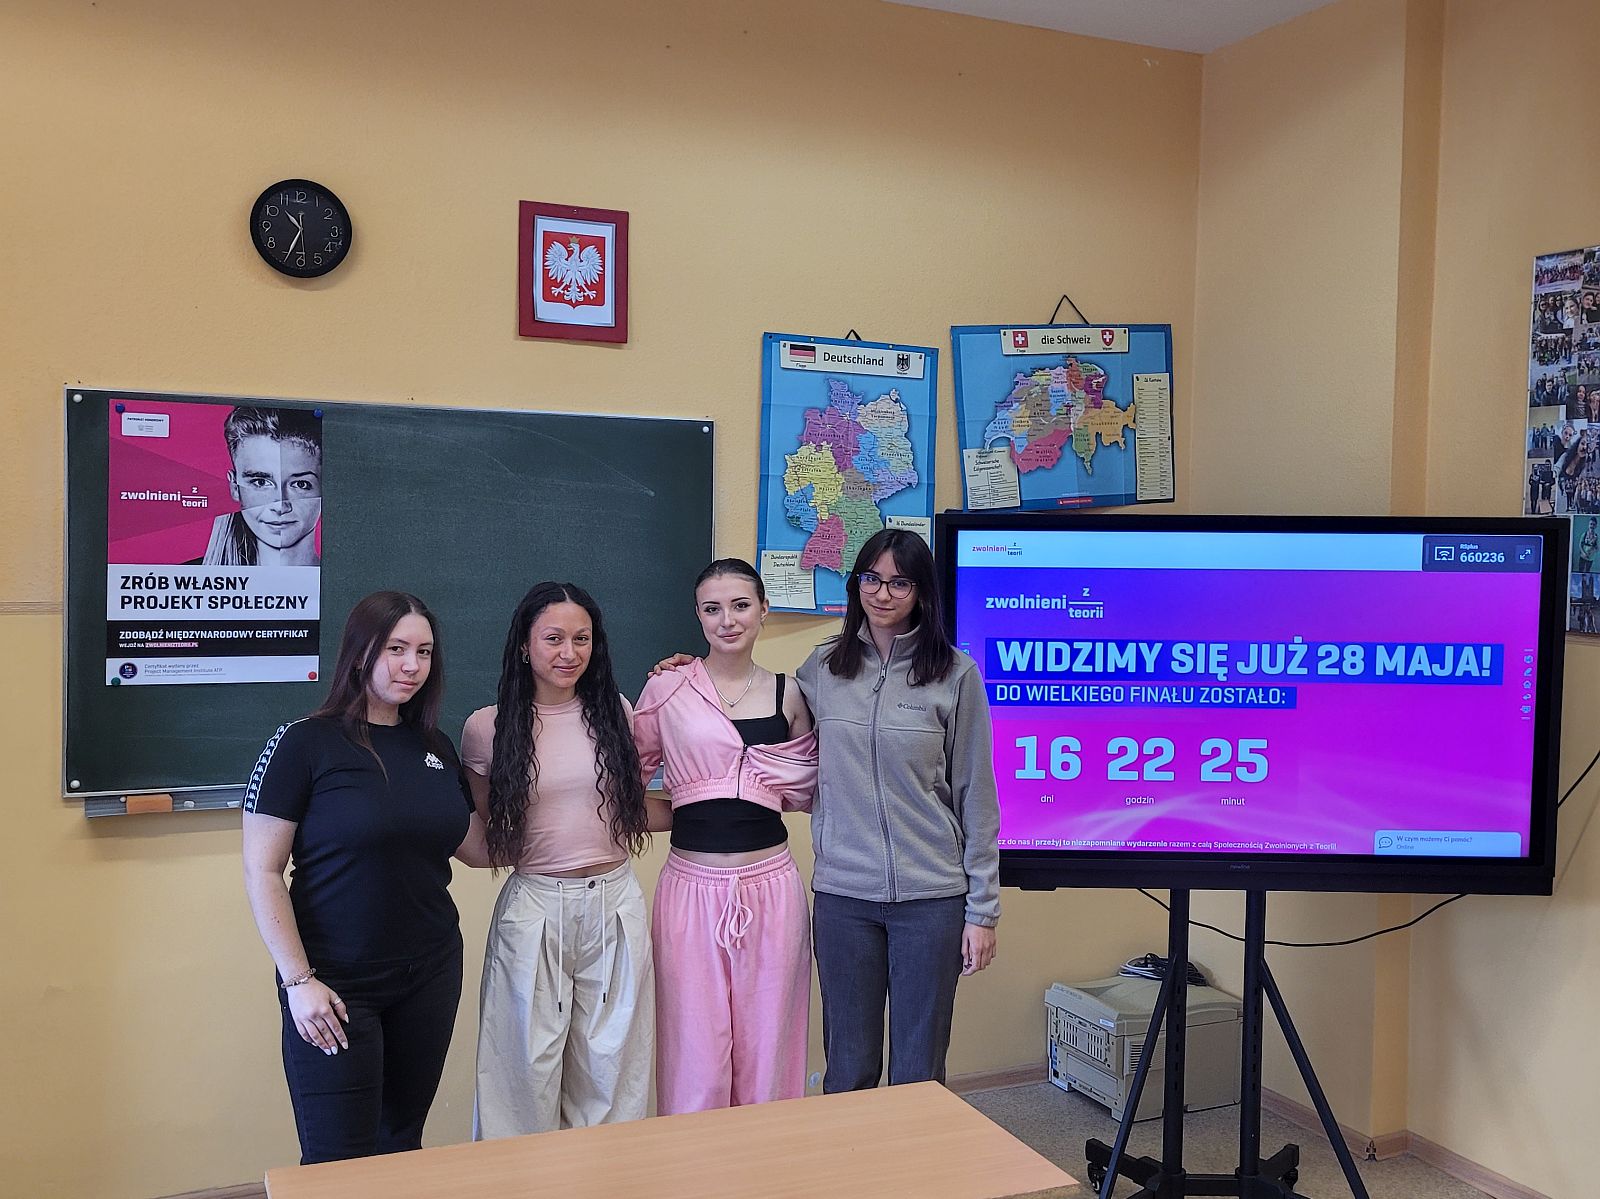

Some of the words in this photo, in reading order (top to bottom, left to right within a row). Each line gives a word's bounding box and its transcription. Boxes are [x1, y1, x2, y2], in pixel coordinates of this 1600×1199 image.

[280, 193, 288, 206] 11
[296, 190, 306, 204] 12
[315, 196, 318, 207] 1
[266, 204, 279, 216] 10
[324, 208, 332, 220] 2
[262, 220, 272, 232] 9
[330, 226, 338, 238] 3
[267, 236, 276, 248] 8
[324, 241, 332, 253] 4
[314, 252, 322, 264] 5
[1041, 335, 1055, 345] die
[1057, 335, 1091, 345] Schweiz
[823, 352, 884, 366] Deutschland
[120, 490, 180, 500] zwolnieni
[182, 500, 208, 508] teorii
[1460, 552, 1505, 563] 660236
[120, 572, 170, 590] ZRÓB
[174, 576, 250, 590] WŁASNY
[1082, 587, 1090, 597] z
[120, 596, 204, 610] PROJEKT
[208, 596, 309, 610] SPOŁECZNY
[986, 594, 1067, 609] zwolnieni
[1068, 606, 1104, 618] teorii
[119, 629, 164, 640] ZDOBĄDŹ
[166, 630, 254, 640] MIĘDZYNARODOWY
[256, 630, 309, 638] CERTYFIKAT
[996, 641, 1163, 673] WIDZIMY
[1170, 642, 1229, 682] SIĘ
[1236, 636, 1308, 676] JUŻ
[1317, 644, 1365, 676] 28
[1375, 645, 1492, 678] MAJA!
[996, 684, 1021, 702] DO
[1026, 685, 1124, 702] WIELKIEGO
[1130, 686, 1194, 704] FINAŁU
[1200, 687, 1286, 704] ZOSTAŁO:
[1014, 736, 1082, 780] 16
[1107, 736, 1176, 781] 22
[1200, 738, 1269, 782] 25
[1040, 794, 1054, 804] dni
[1125, 795, 1154, 806] godzin
[1220, 796, 1246, 806] minut
[1036, 839, 1062, 848] przeżyj
[1072, 840, 1126, 848] niezapomniane
[1213, 842, 1263, 850] Społecznością
[1264, 842, 1308, 850] Zwolnionych
